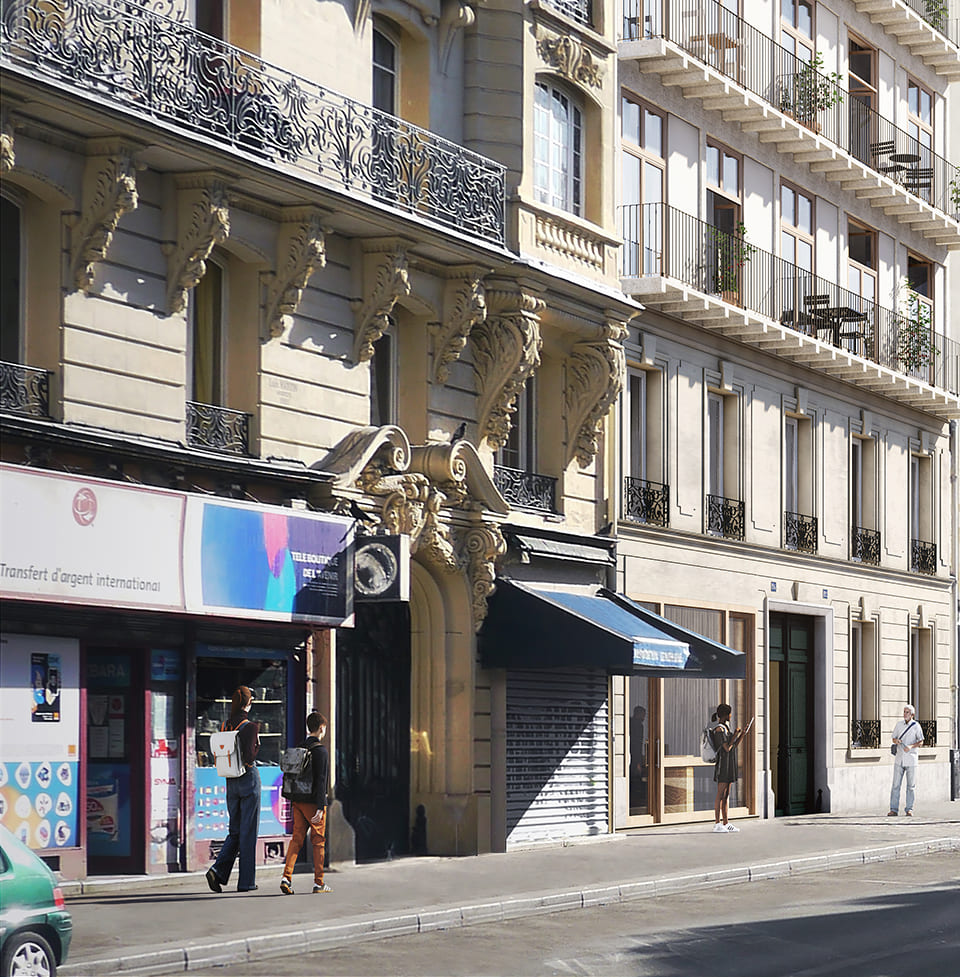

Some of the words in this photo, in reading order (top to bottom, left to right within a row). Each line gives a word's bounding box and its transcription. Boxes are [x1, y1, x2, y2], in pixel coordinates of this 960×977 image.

[0, 563, 48, 581] Transfert
[51, 568, 93, 588] d'argent
[96, 573, 160, 592] international
